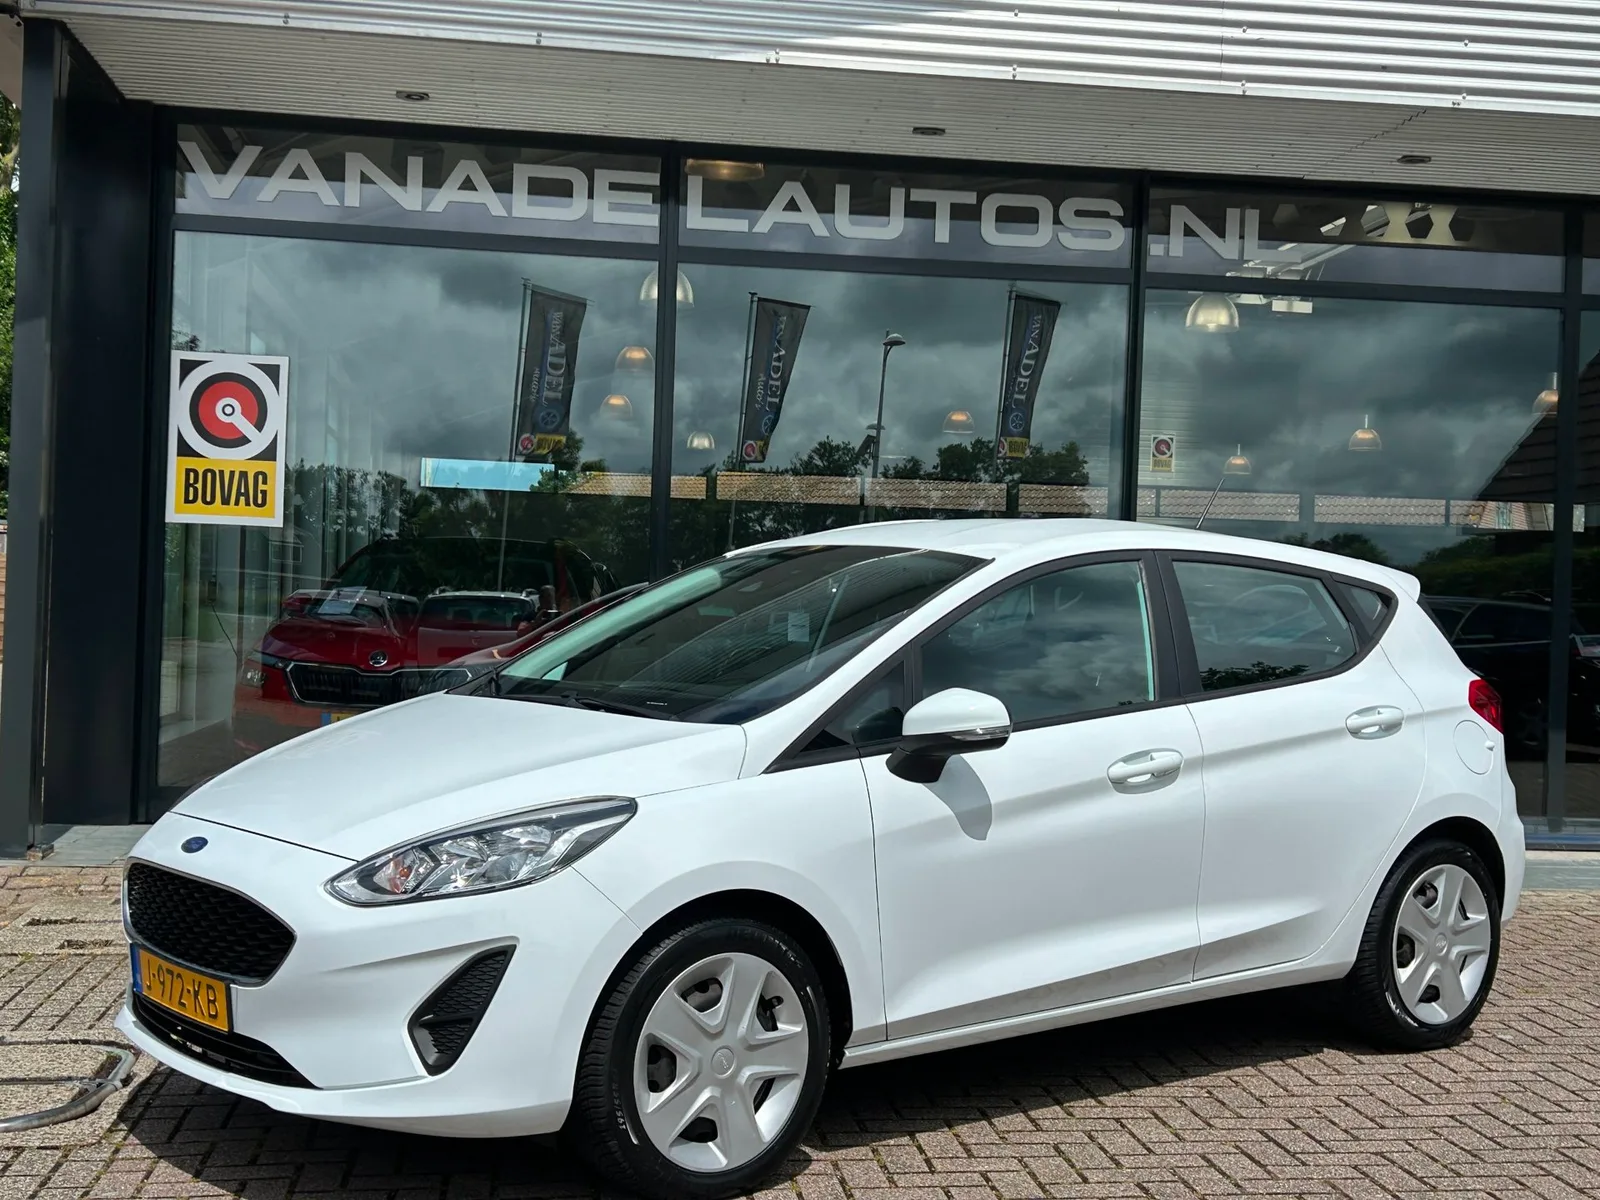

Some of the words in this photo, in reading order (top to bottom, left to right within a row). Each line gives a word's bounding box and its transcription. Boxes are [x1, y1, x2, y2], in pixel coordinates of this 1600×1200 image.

[766, 343, 786, 411] ADEL
[1011, 340, 1039, 408] ADEL
[183, 467, 268, 508] BOVAG
[144, 958, 219, 1019] J-972-KB
